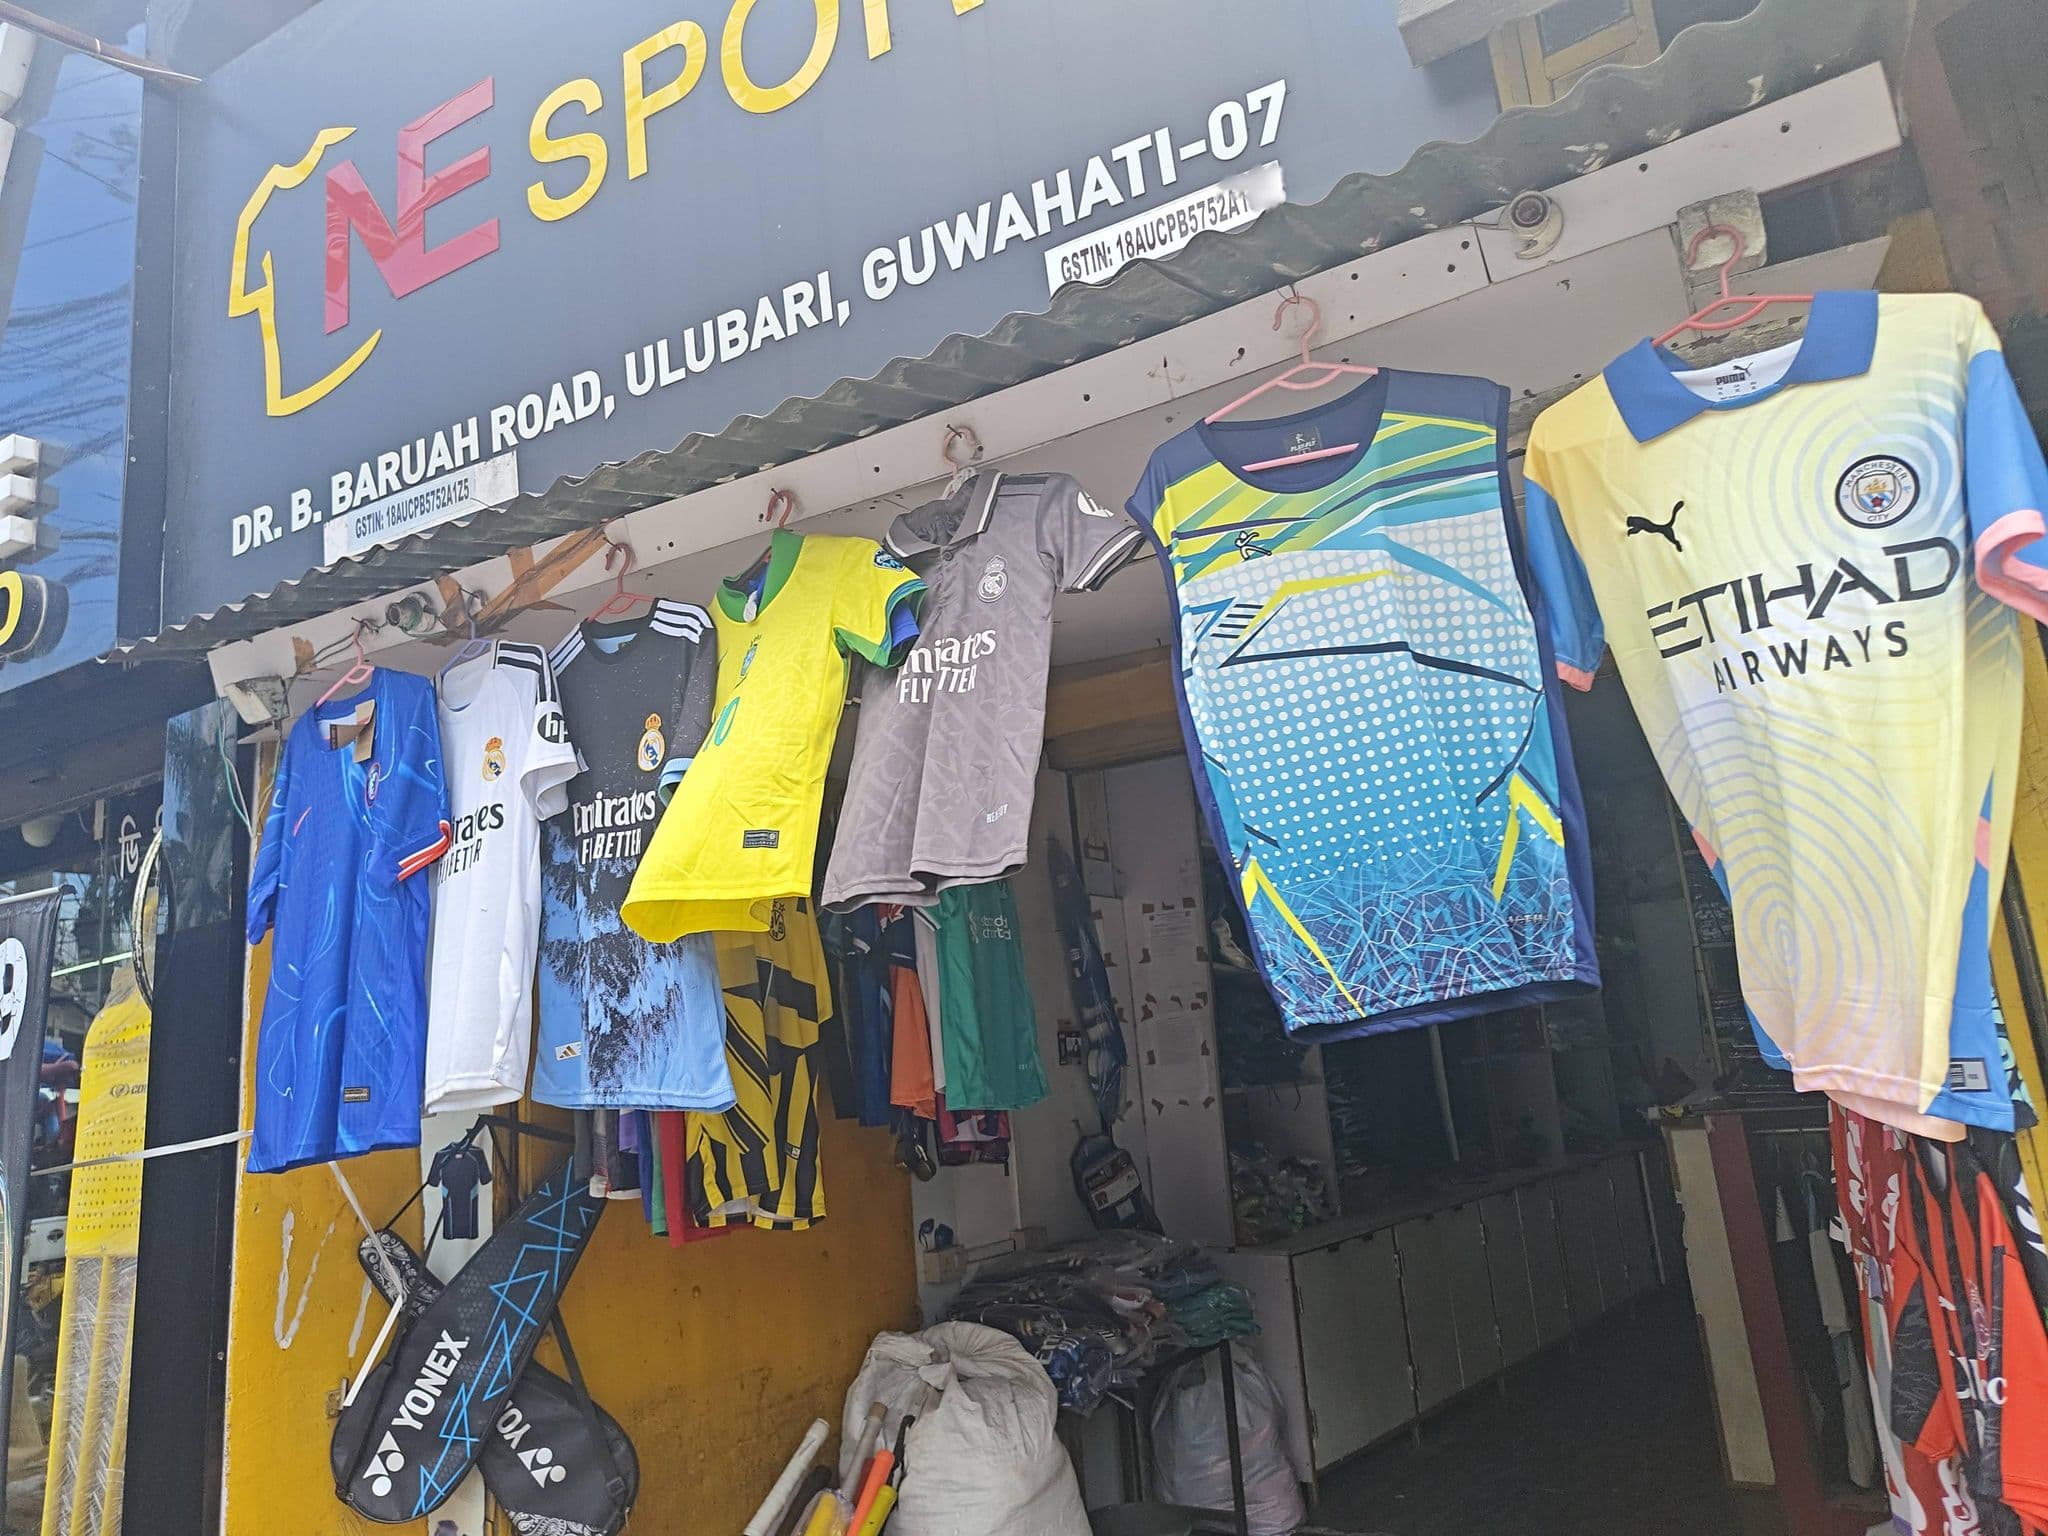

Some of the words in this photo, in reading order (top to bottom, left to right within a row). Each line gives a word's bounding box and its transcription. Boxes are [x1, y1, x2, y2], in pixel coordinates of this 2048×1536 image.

[325, 76, 499, 334] NE
[1060, 241, 1113, 283] GSTIN:
[1115, 190, 1249, 262] 18AUCPB5752A1
[232, 505, 282, 557] DR.
[291, 488, 322, 531] B.
[331, 417, 479, 515] BARUAH
[491, 369, 615, 453] ROAD,
[625, 270, 850, 396] ULUBARI,
[862, 79, 1286, 300] GUWAHATI-07
[355, 514, 384, 540] GSTIN:
[386, 478, 470, 530] 18AUCPB5752A1Z5
[1845, 461, 1909, 488] MANCHESTER
[1866, 513, 1889, 522] CITY
[1647, 537, 1960, 658] ETIHAD
[899, 677, 932, 704] FLY
[937, 664, 978, 694] TTER
[1713, 621, 1908, 693] AIRWAYS
[391, 1330, 469, 1431] YONEX
[496, 1400, 531, 1450] YO
